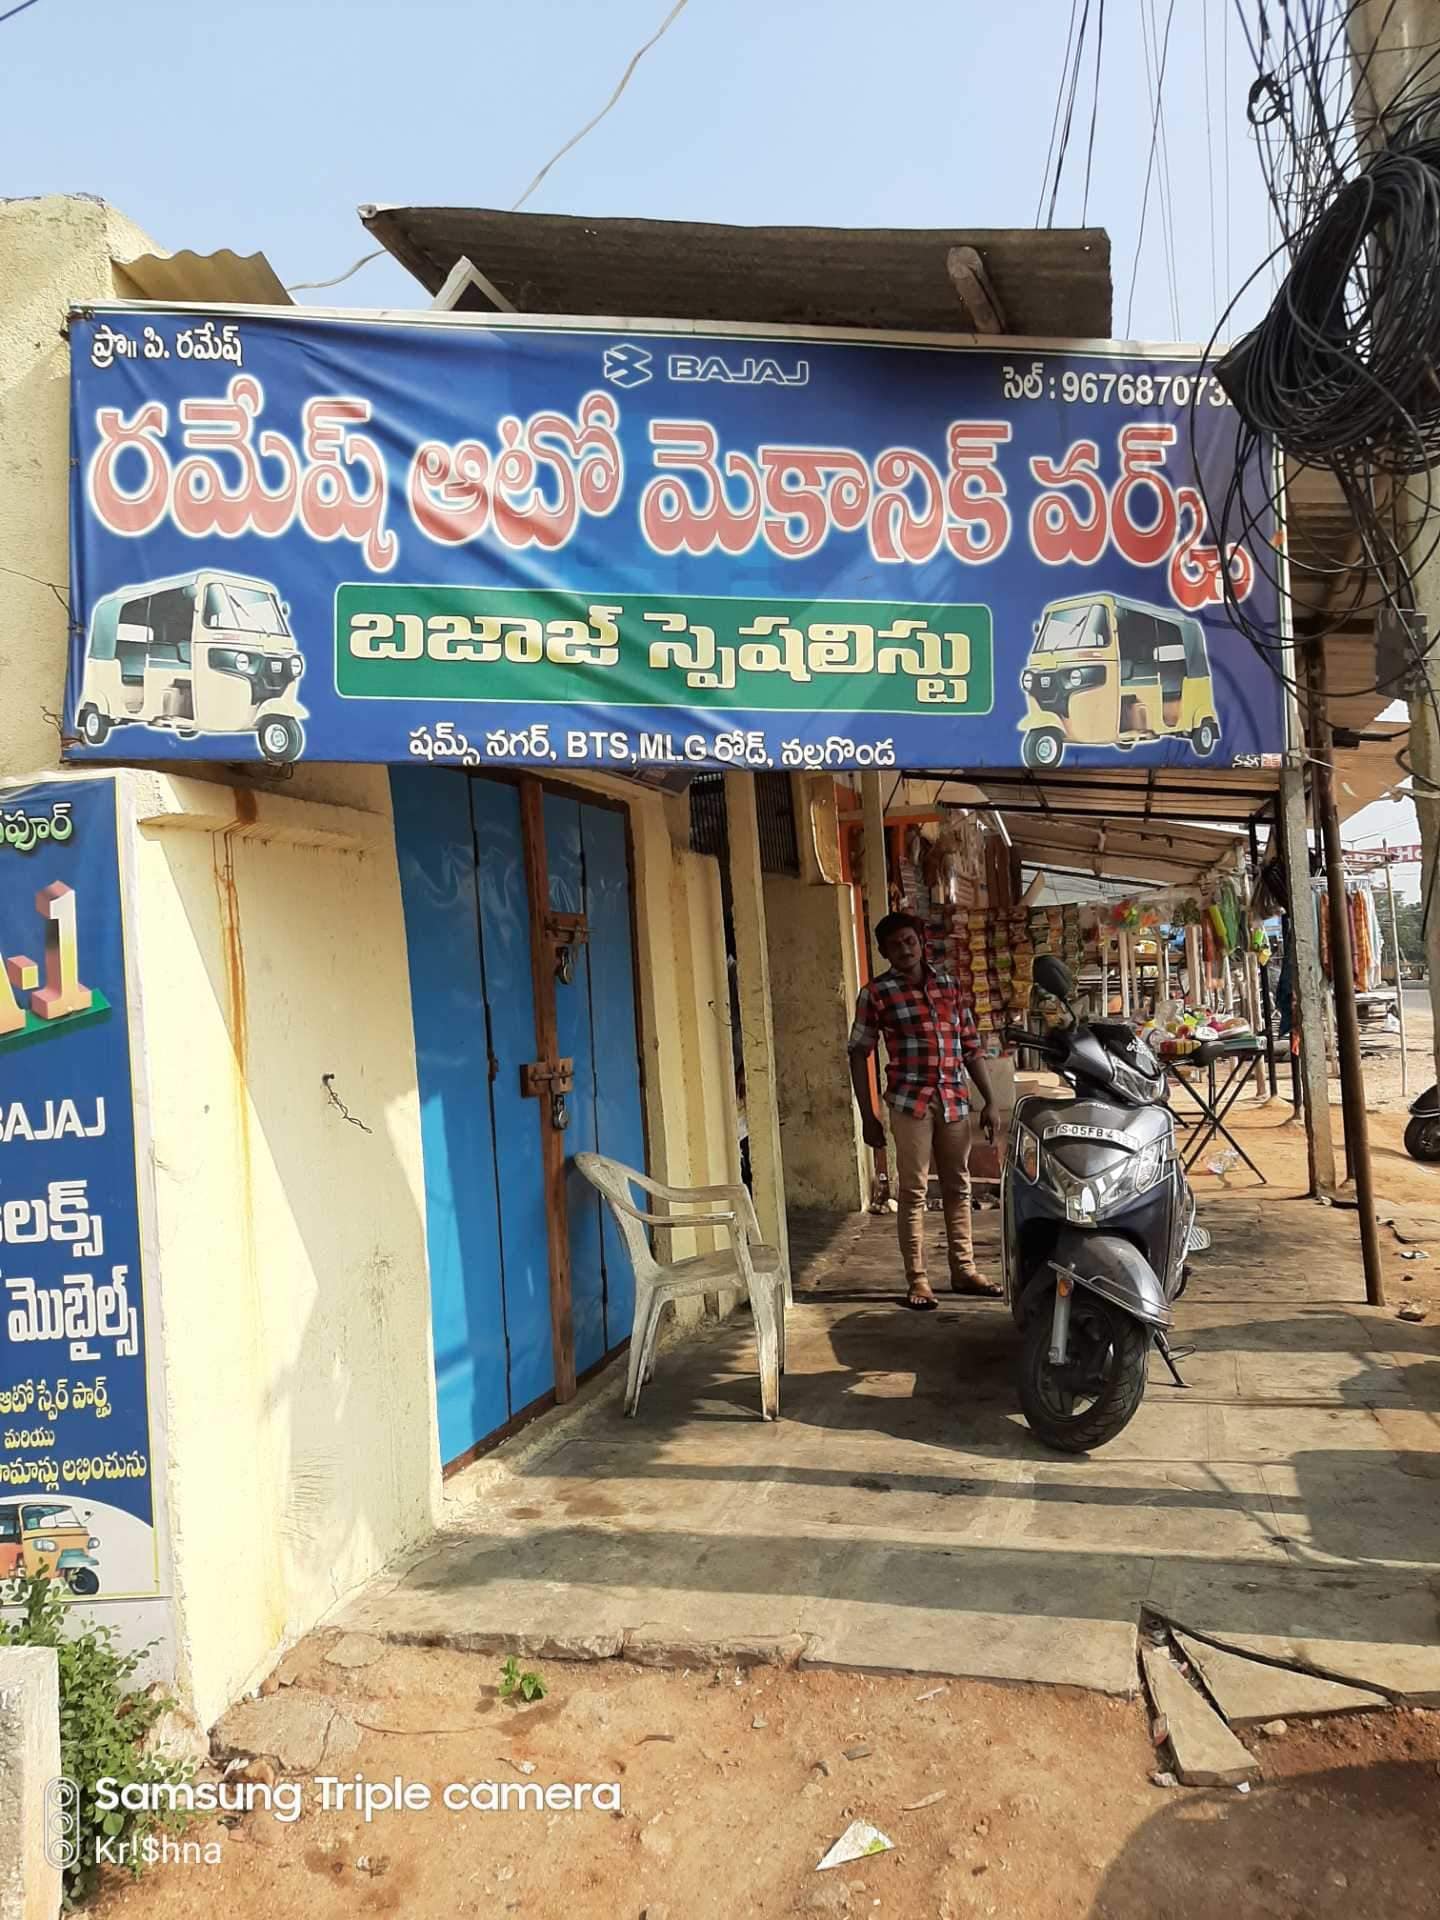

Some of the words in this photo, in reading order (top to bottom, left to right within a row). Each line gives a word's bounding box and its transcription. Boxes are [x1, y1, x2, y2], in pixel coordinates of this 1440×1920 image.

[176, 322, 242, 366] రమేష్
[668, 355, 809, 385] BAJAJ
[1062, 371, 1233, 407] 967687073
[88, 374, 397, 572] రమేష్
[406, 390, 624, 550] ఆటో
[641, 420, 1012, 565] మెకానిక్
[350, 605, 623, 666] బజాజ్
[486, 724, 557, 762] నగర్,
[0, 803, 72, 851] పూర్
[0, 1096, 106, 1143] AJAJ
[0, 1180, 104, 1258] లక్స్
[4, 1427, 55, 1449] మరియు
